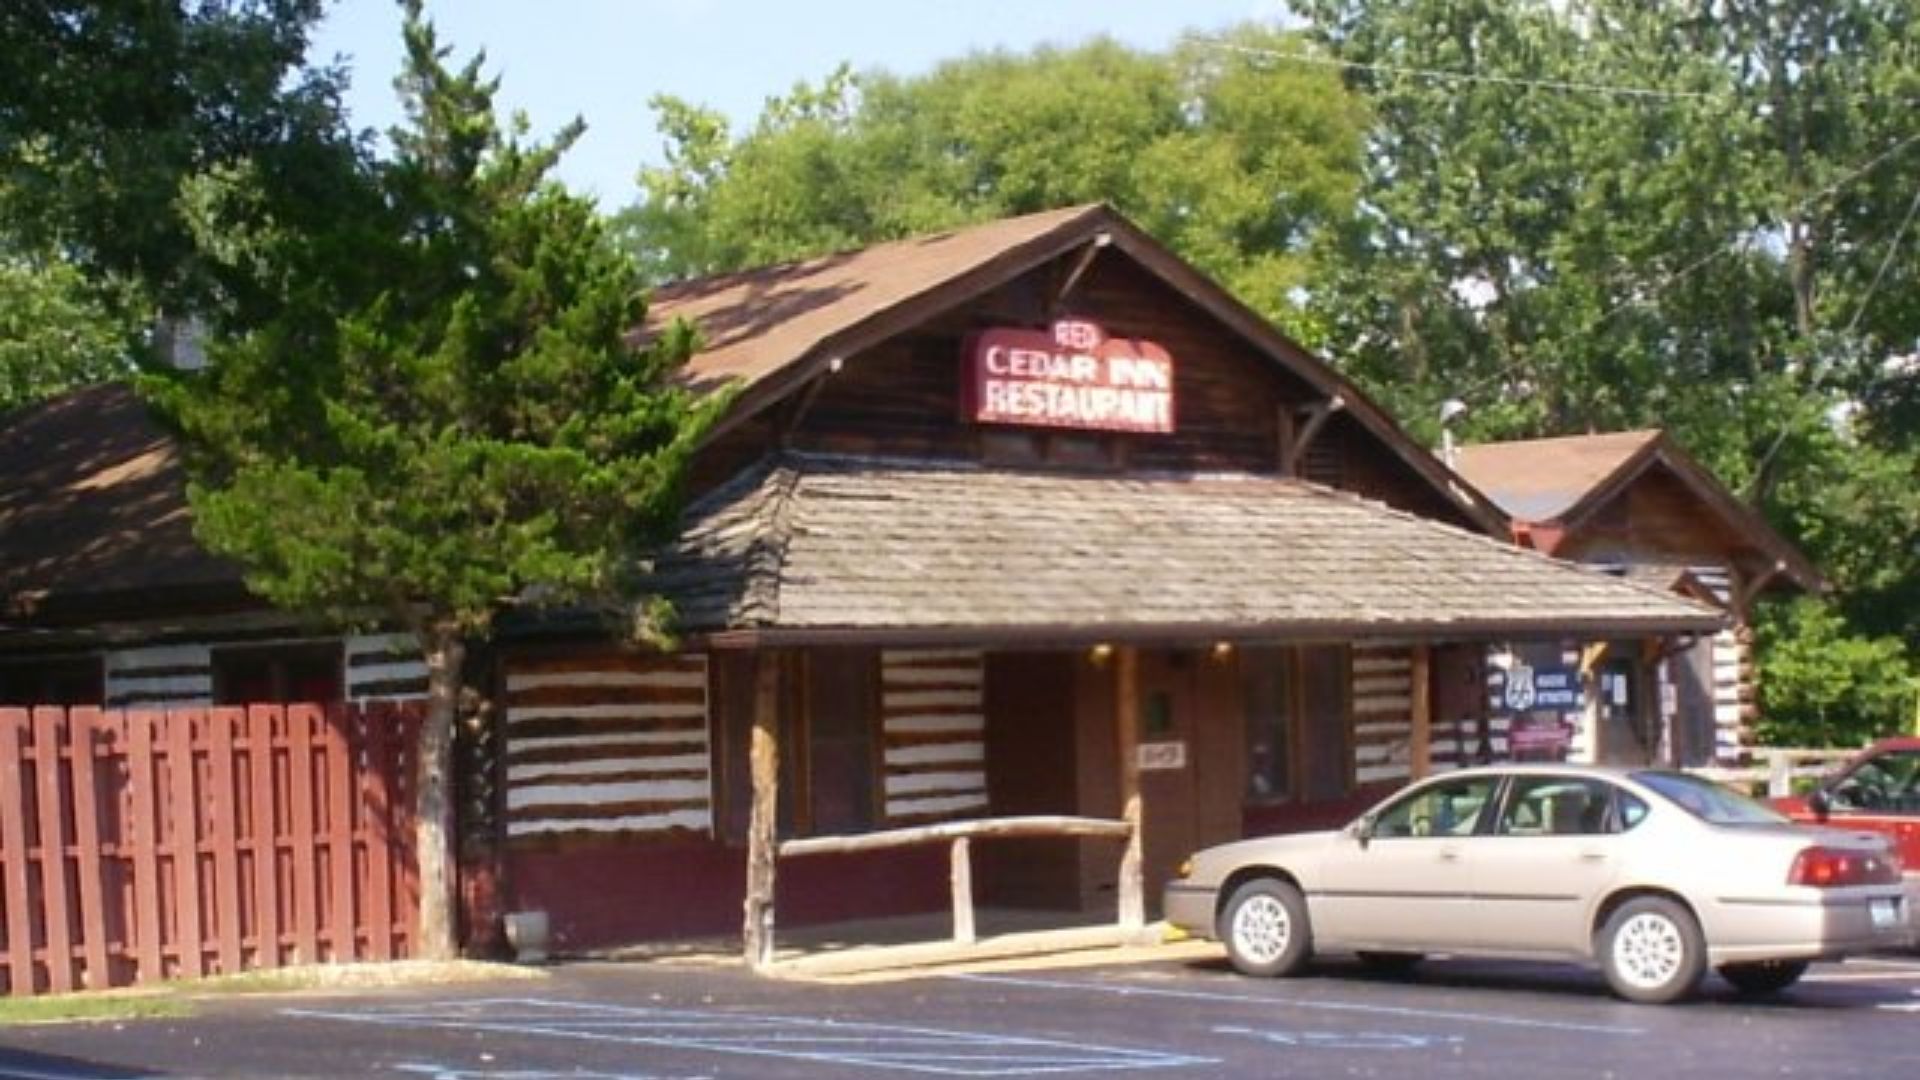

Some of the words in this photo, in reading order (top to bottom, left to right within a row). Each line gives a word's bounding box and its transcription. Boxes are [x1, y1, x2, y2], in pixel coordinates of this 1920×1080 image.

[1055, 320, 1099, 349] RED
[986, 347, 1098, 380] CEDAR
[1108, 357, 1168, 388] INN
[985, 380, 1172, 421] RESTAURANT
